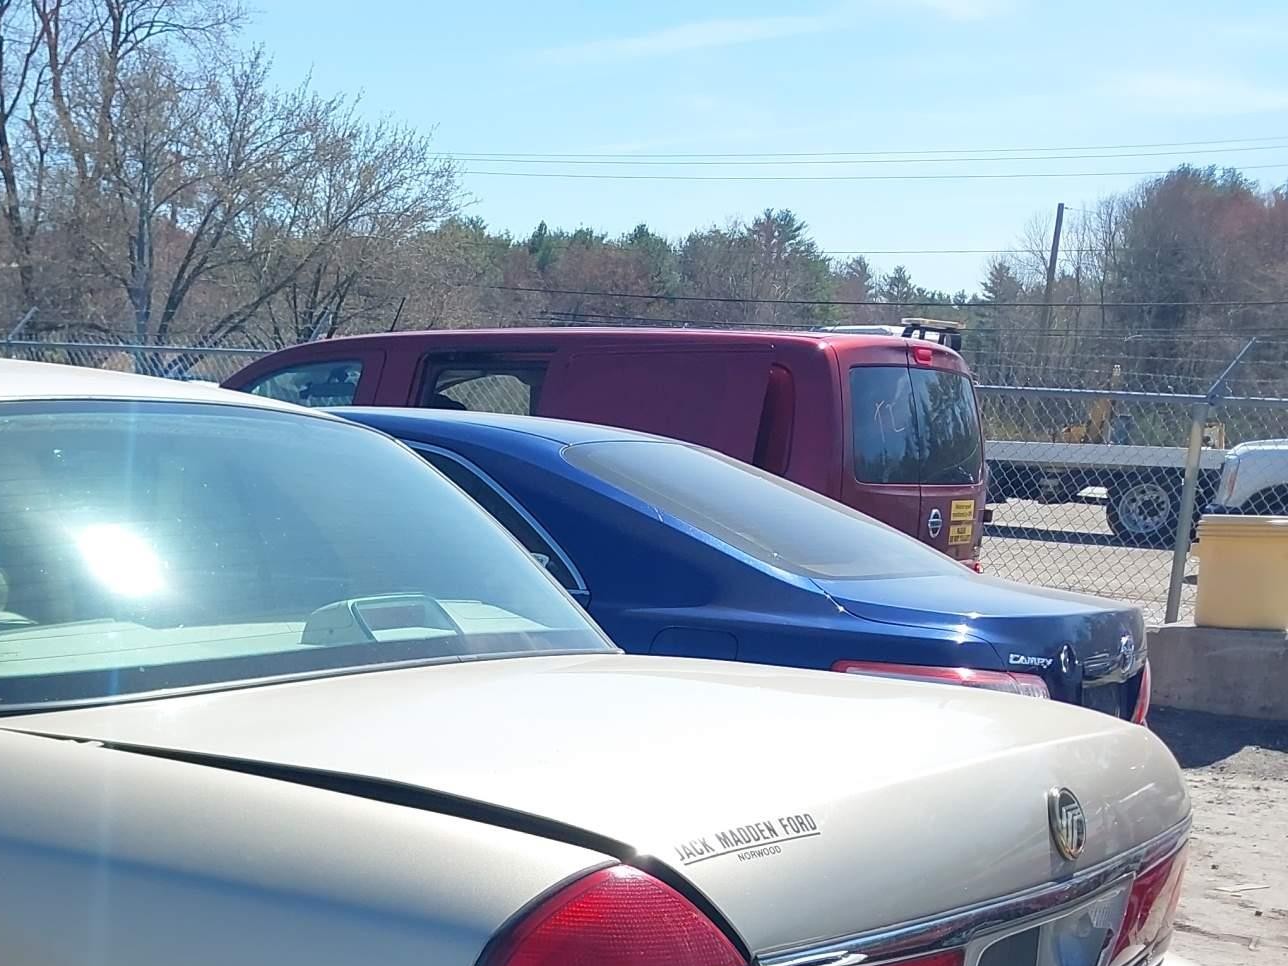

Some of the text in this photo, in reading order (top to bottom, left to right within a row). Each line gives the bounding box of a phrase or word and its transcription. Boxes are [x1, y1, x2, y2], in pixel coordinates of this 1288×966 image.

[1009, 653, 1054, 669] CAMRY
[674, 813, 818, 862] JACK MADDEN FORD
[737, 845, 783, 863] NORWOOD
